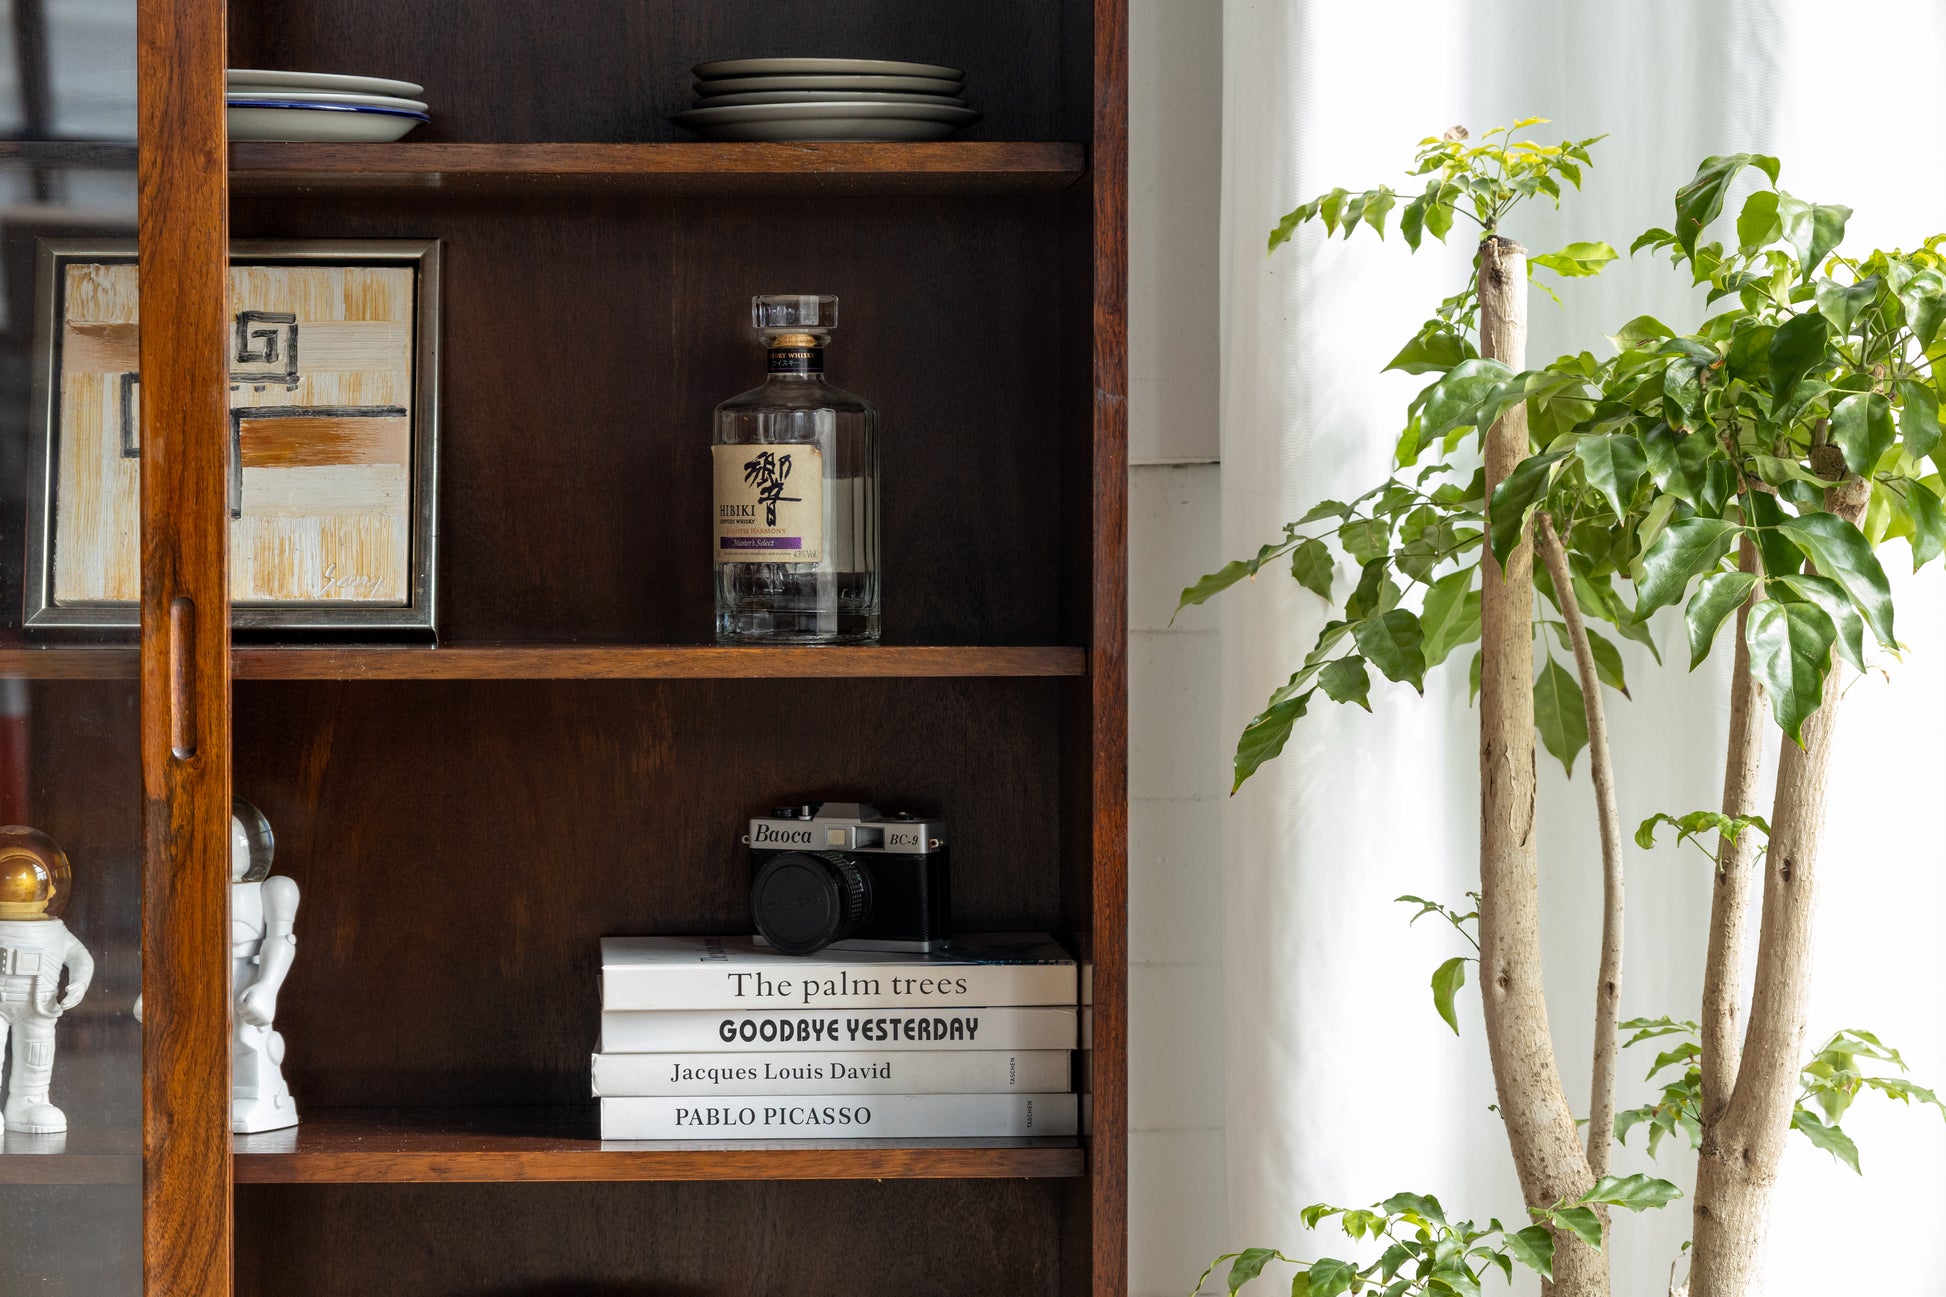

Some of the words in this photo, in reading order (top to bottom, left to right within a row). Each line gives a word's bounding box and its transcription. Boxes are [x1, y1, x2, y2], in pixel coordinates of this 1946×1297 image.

[720, 504, 755, 517] HIBIKI
[750, 527, 787, 535] HARMONY
[755, 539, 775, 548] Select
[754, 823, 813, 844] Baoca
[890, 833, 919, 846] BC-9
[727, 972, 792, 997] The
[802, 971, 881, 1004] palm
[892, 975, 968, 995] trees
[719, 1019, 839, 1043] GOODBYE
[846, 1017, 979, 1041] YESTERDAY
[670, 1064, 757, 1084] Jacques
[763, 1063, 823, 1080] Louis
[830, 1062, 892, 1079] David
[674, 1108, 756, 1126] PABLO
[763, 1106, 872, 1125] PICASSO
